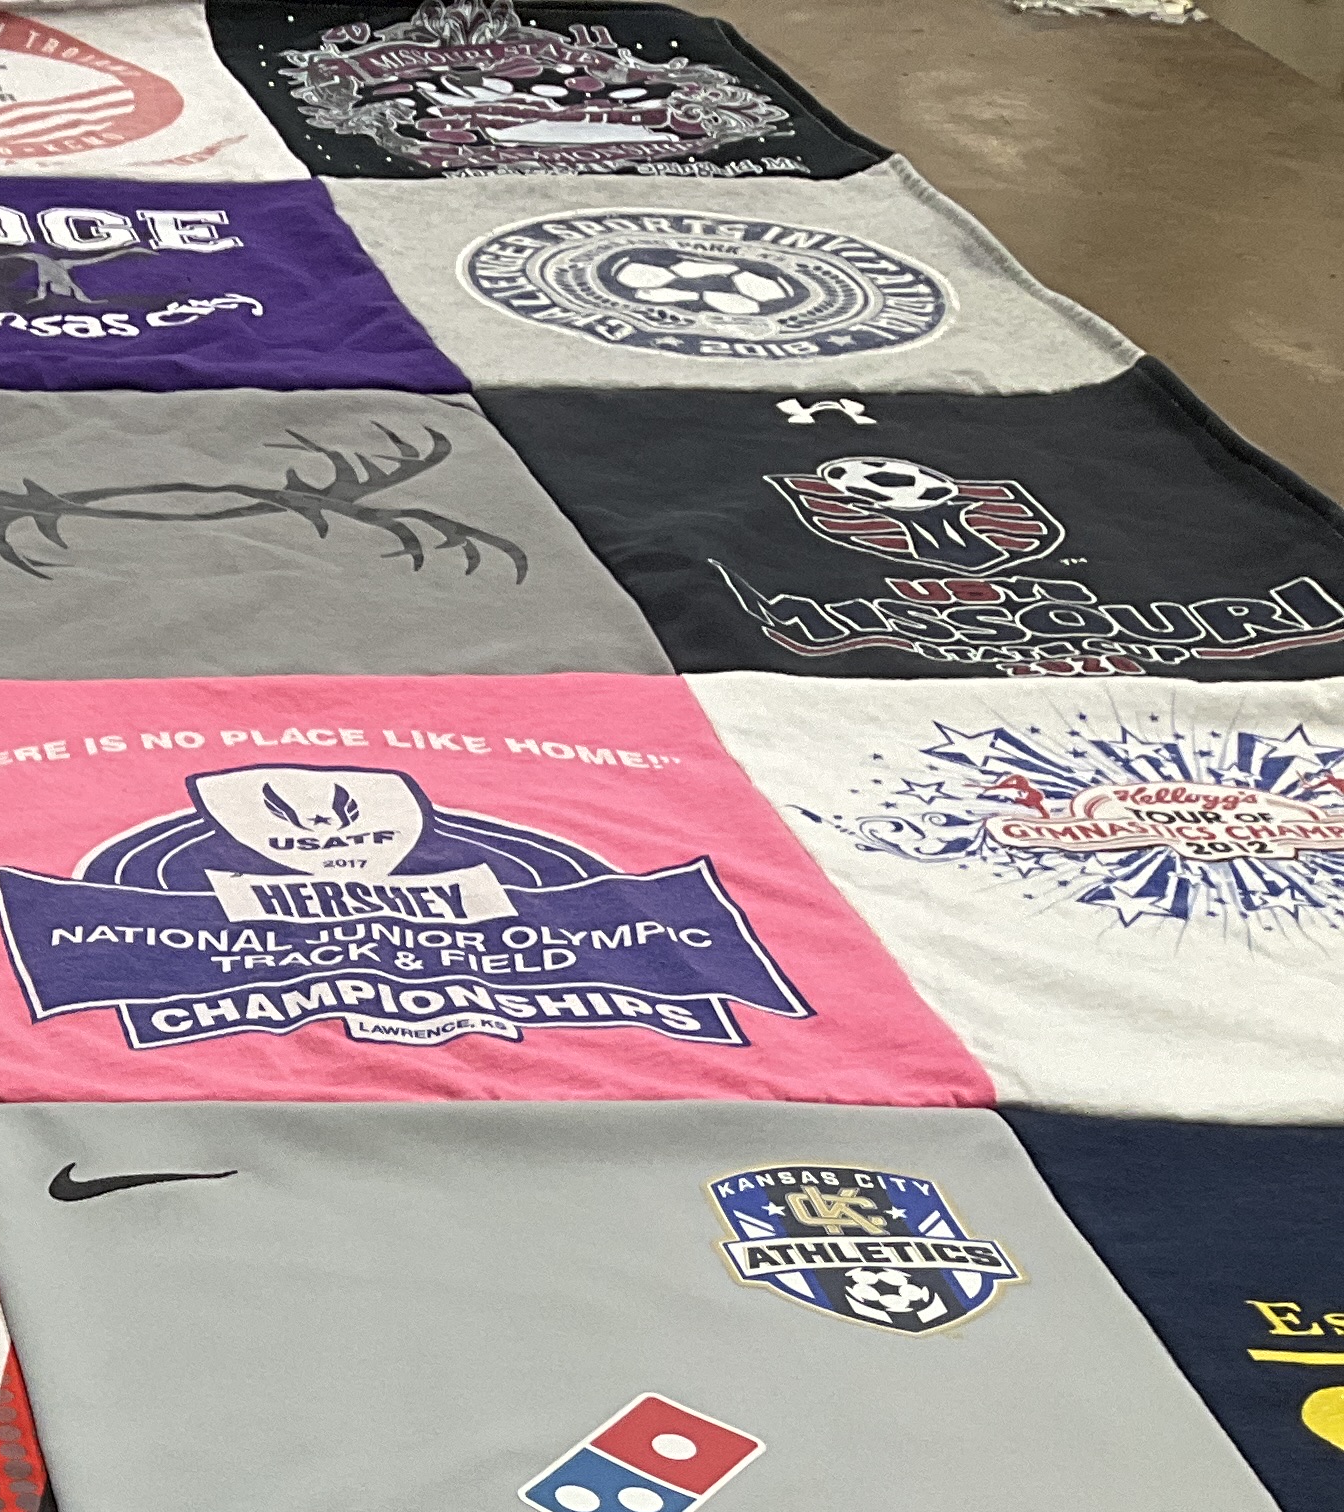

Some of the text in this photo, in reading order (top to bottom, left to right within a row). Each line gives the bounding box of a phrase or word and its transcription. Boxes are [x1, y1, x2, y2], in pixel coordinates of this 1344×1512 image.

[542, 217, 746, 242] SPORTS
[763, 225, 934, 341] INVITATIONAL
[145, 293, 264, 328] City
[699, 340, 820, 357] 2018
[767, 577, 1344, 643] MISSOURI
[85, 731, 128, 756] IS
[143, 729, 203, 752] NO
[222, 728, 364, 751] PLACE
[381, 728, 494, 753] LIKE
[1113, 786, 1257, 811] Kellogg's
[1124, 807, 1275, 825] TOUR OF
[269, 830, 397, 850] USATF
[1002, 820, 1217, 843] GYMNASTICS
[1186, 840, 1274, 856] 2012
[323, 858, 368, 869] 2017
[249, 881, 469, 919] HERSHEY
[50, 922, 713, 952] NATIONAL JUNIOR OLYMPIC
[210, 943, 578, 974] TRACK & FIELD
[150, 978, 703, 1034] CHAMPIONSHIPS
[359, 1018, 475, 1039] LAWRENCE,
[717, 1170, 934, 1199] KANSAS CITY
[747, 1240, 1003, 1270] ATHLETICS
